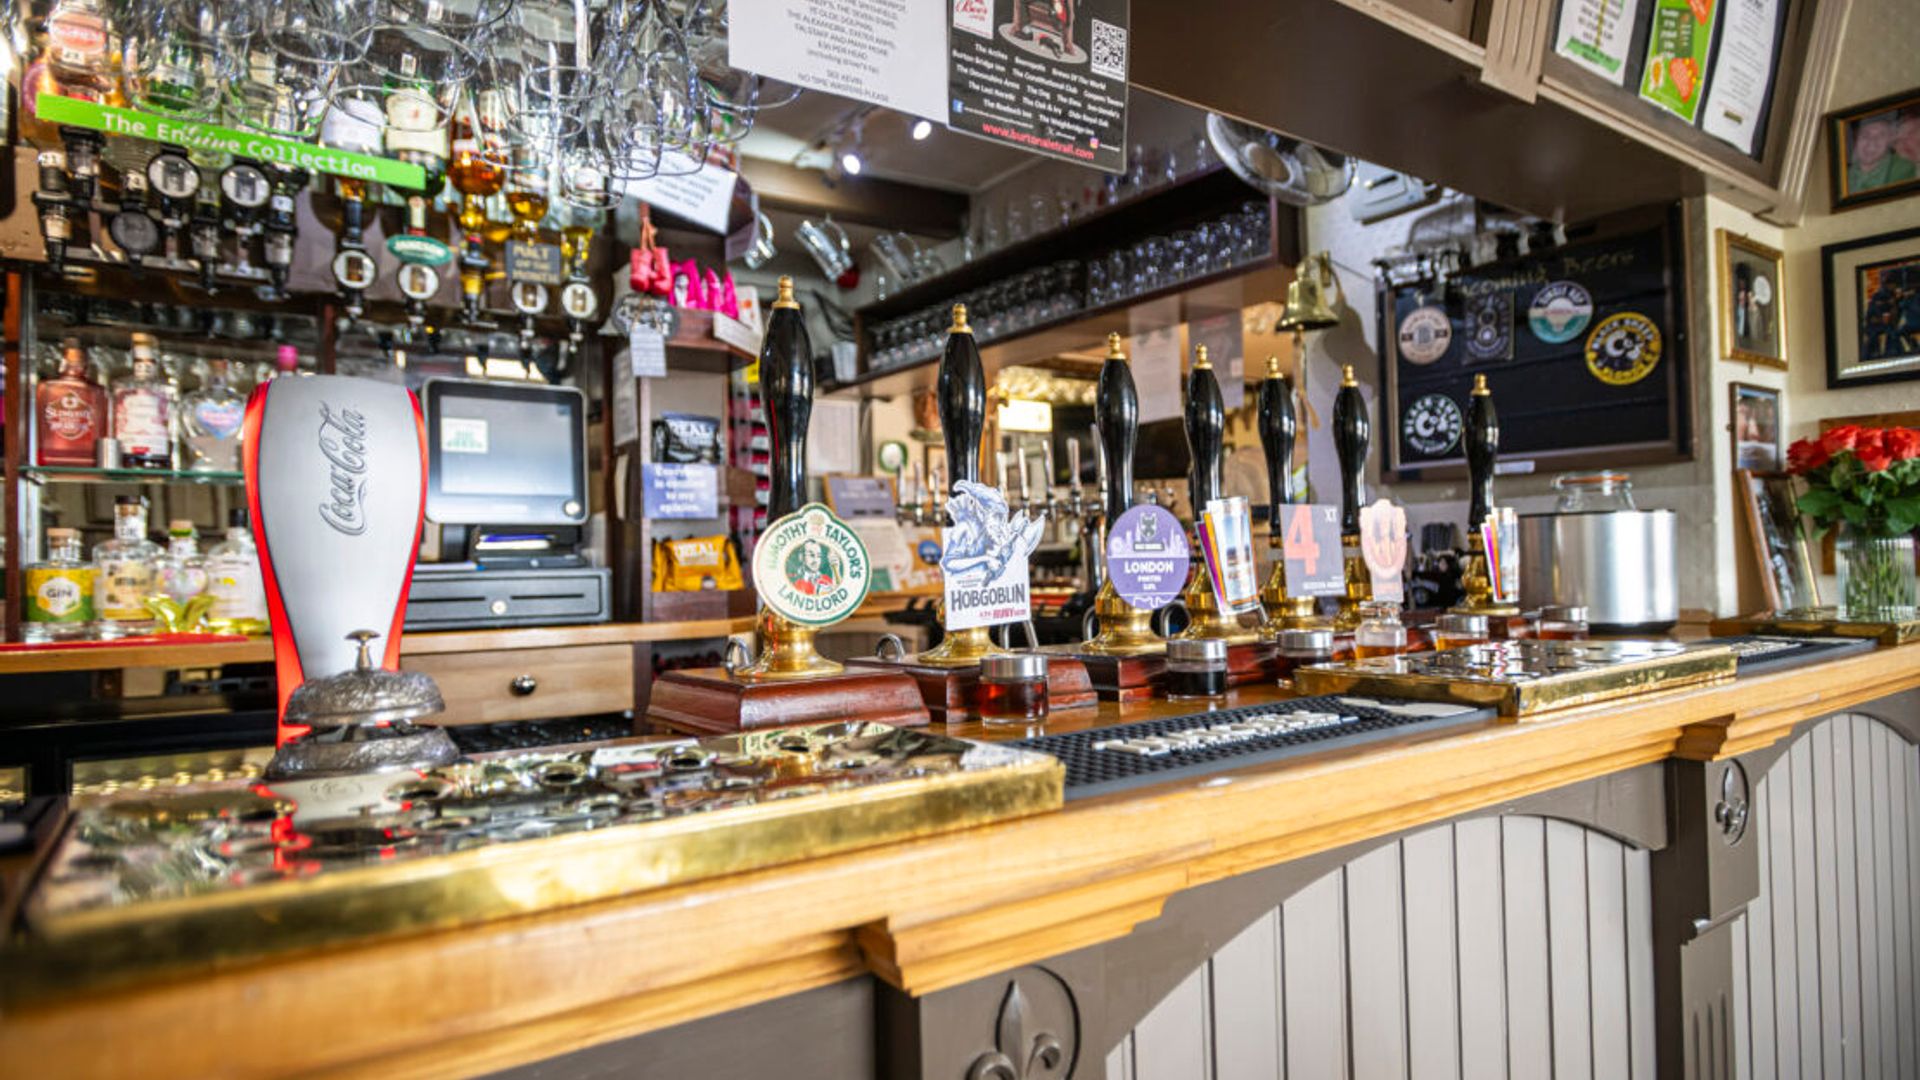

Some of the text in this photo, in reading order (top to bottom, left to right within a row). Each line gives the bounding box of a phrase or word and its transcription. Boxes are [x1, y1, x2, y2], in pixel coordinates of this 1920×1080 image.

[101, 111, 147, 138] The
[247, 140, 378, 179] Collection
[982, 122, 1095, 161] www.burtonaletrail.com
[1324, 508, 1338, 523] XT
[825, 524, 864, 580] TAYLOR'S
[1284, 504, 1321, 576] 4
[1124, 560, 1174, 574] LONDON
[46, 588, 73, 598] GIN
[778, 584, 849, 612] LANDLORD
[951, 583, 1026, 612] HOBGOBLIN
